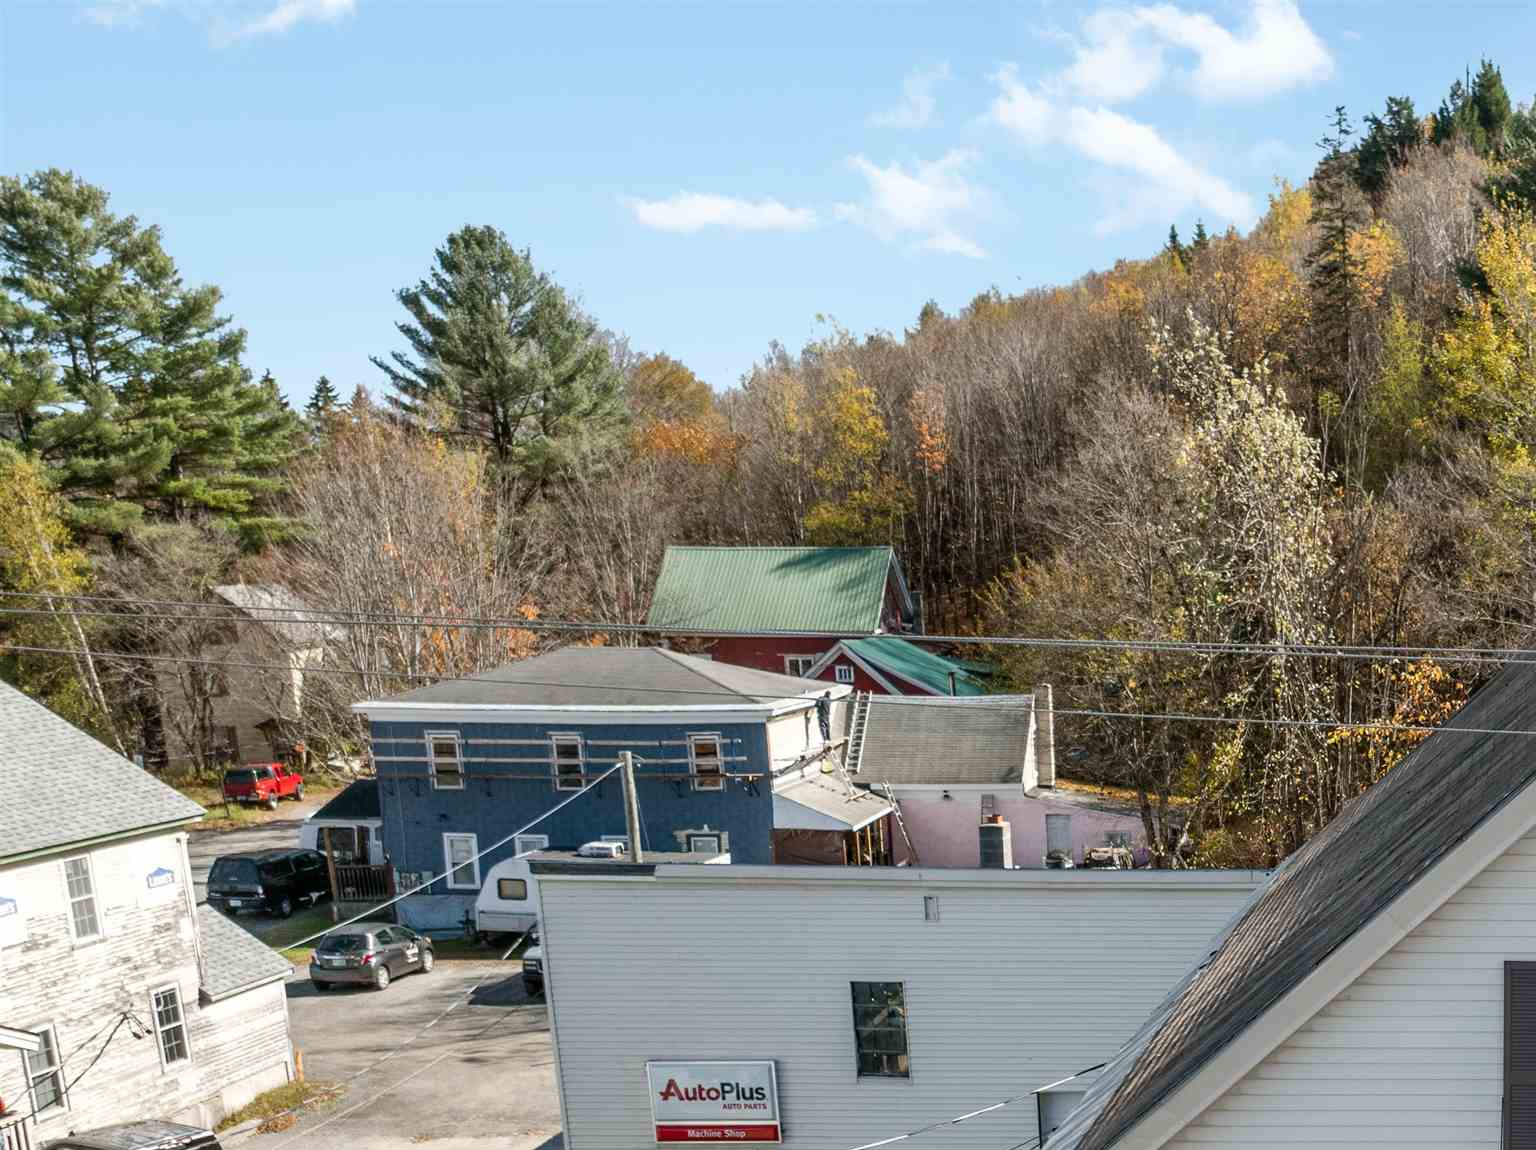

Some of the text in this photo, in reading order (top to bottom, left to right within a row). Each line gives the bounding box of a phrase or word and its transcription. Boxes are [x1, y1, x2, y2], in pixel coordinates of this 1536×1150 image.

[659, 1078, 767, 1101] AutoPlus
[687, 1128, 746, 1138] Machine Shop
